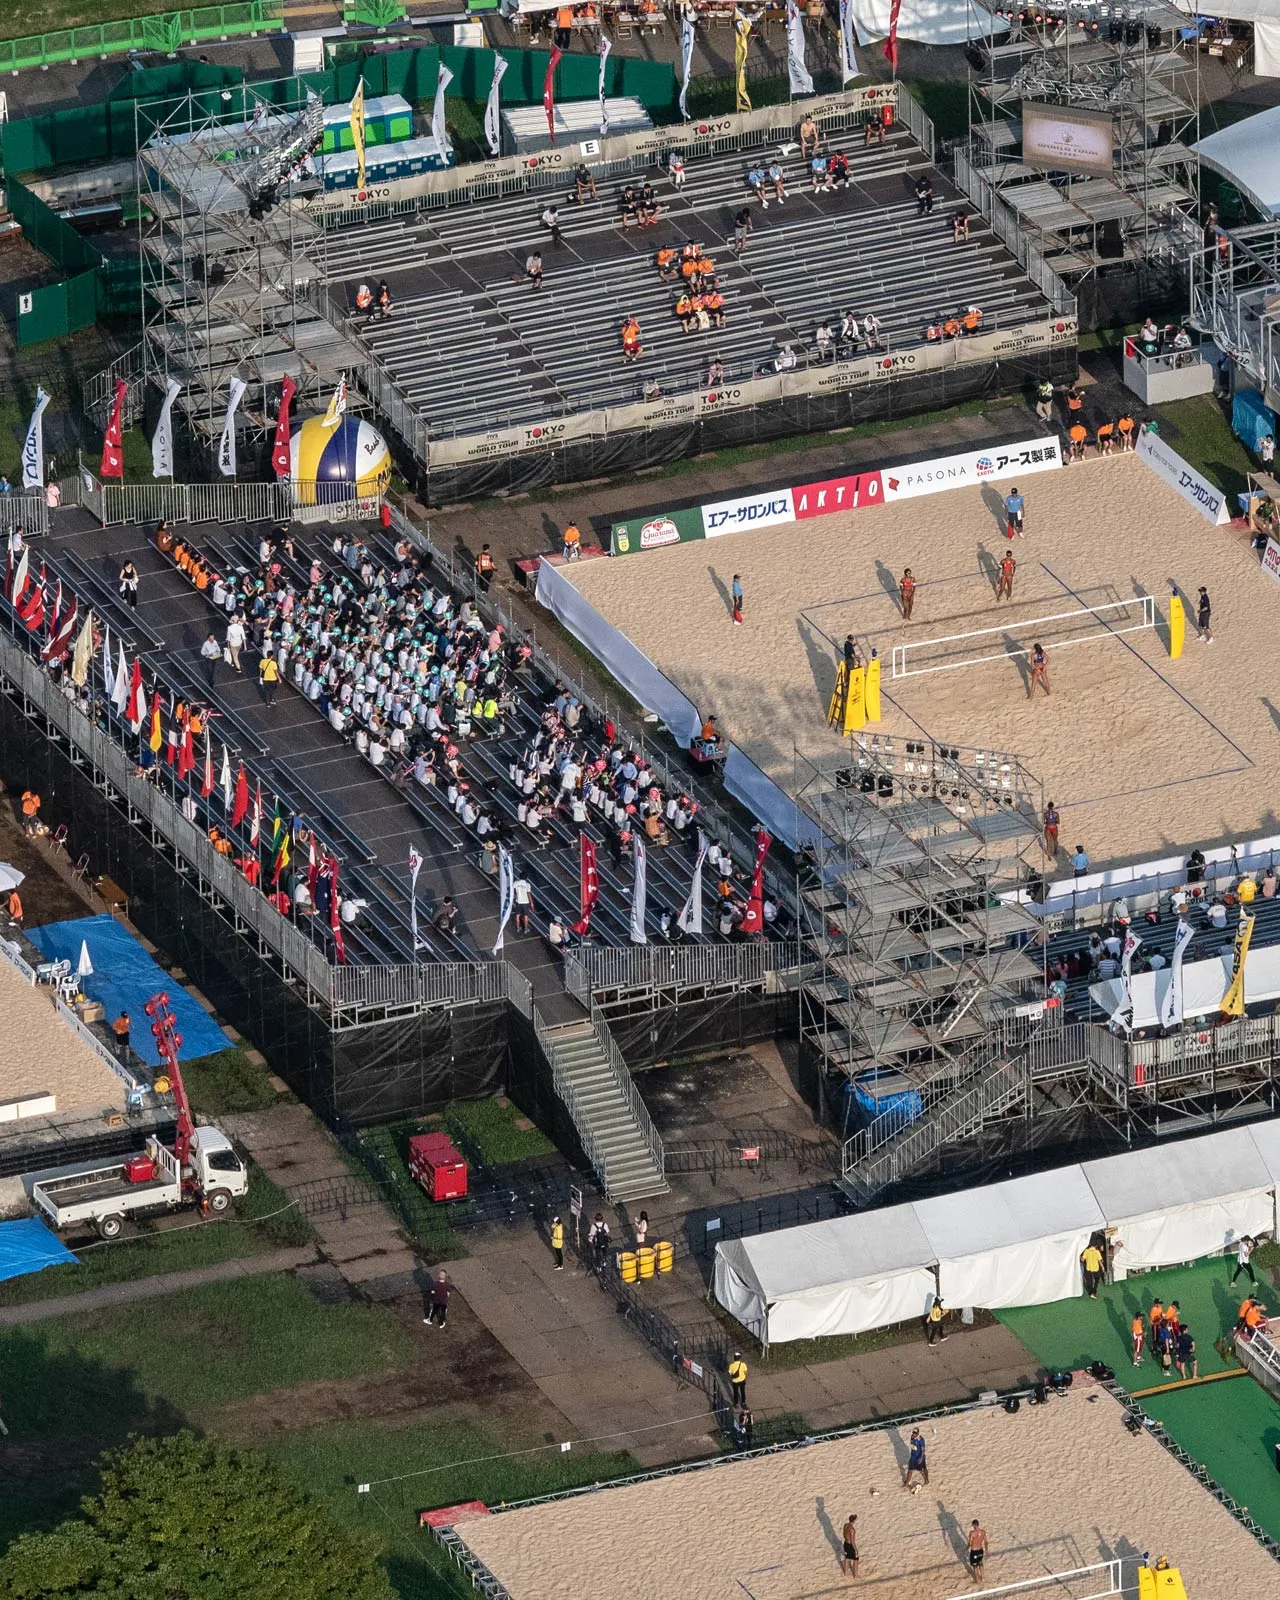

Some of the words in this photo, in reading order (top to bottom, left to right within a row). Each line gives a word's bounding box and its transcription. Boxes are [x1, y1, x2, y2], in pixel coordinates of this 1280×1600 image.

[860, 87, 898, 100] TOKYO
[692, 120, 731, 135] TOKYO
[585, 142, 595, 154] E
[521, 154, 562, 169] TOKYO
[350, 188, 390, 202] TOKYO
[1049, 320, 1079, 335] TOKY
[993, 339, 1022, 352] WORLD
[1023, 335, 1045, 346] TOUR
[1050, 333, 1068, 342] 2019
[875, 355, 916, 370] TOKYO
[818, 374, 848, 386] WORLD
[848, 370, 870, 380] TOUR
[876, 368, 894, 377] 2019
[701, 389, 741, 404] TOKYO
[644, 409, 672, 421] WORLD
[672, 405, 695, 416] TOUR
[701, 403, 719, 412] 2019
[525, 423, 565, 439] TOKYO
[468, 443, 497, 455] WORLD
[497, 440, 519, 450] TOUR
[525, 437, 543, 447] 2019
[996, 446, 1057, 470] アース製薬
[907, 466, 967, 486] PASONA
[799, 477, 879, 511] AKTIO
[1178, 470, 1219, 514] エアーサロンパス
[707, 499, 791, 529] エアーサロンパス
